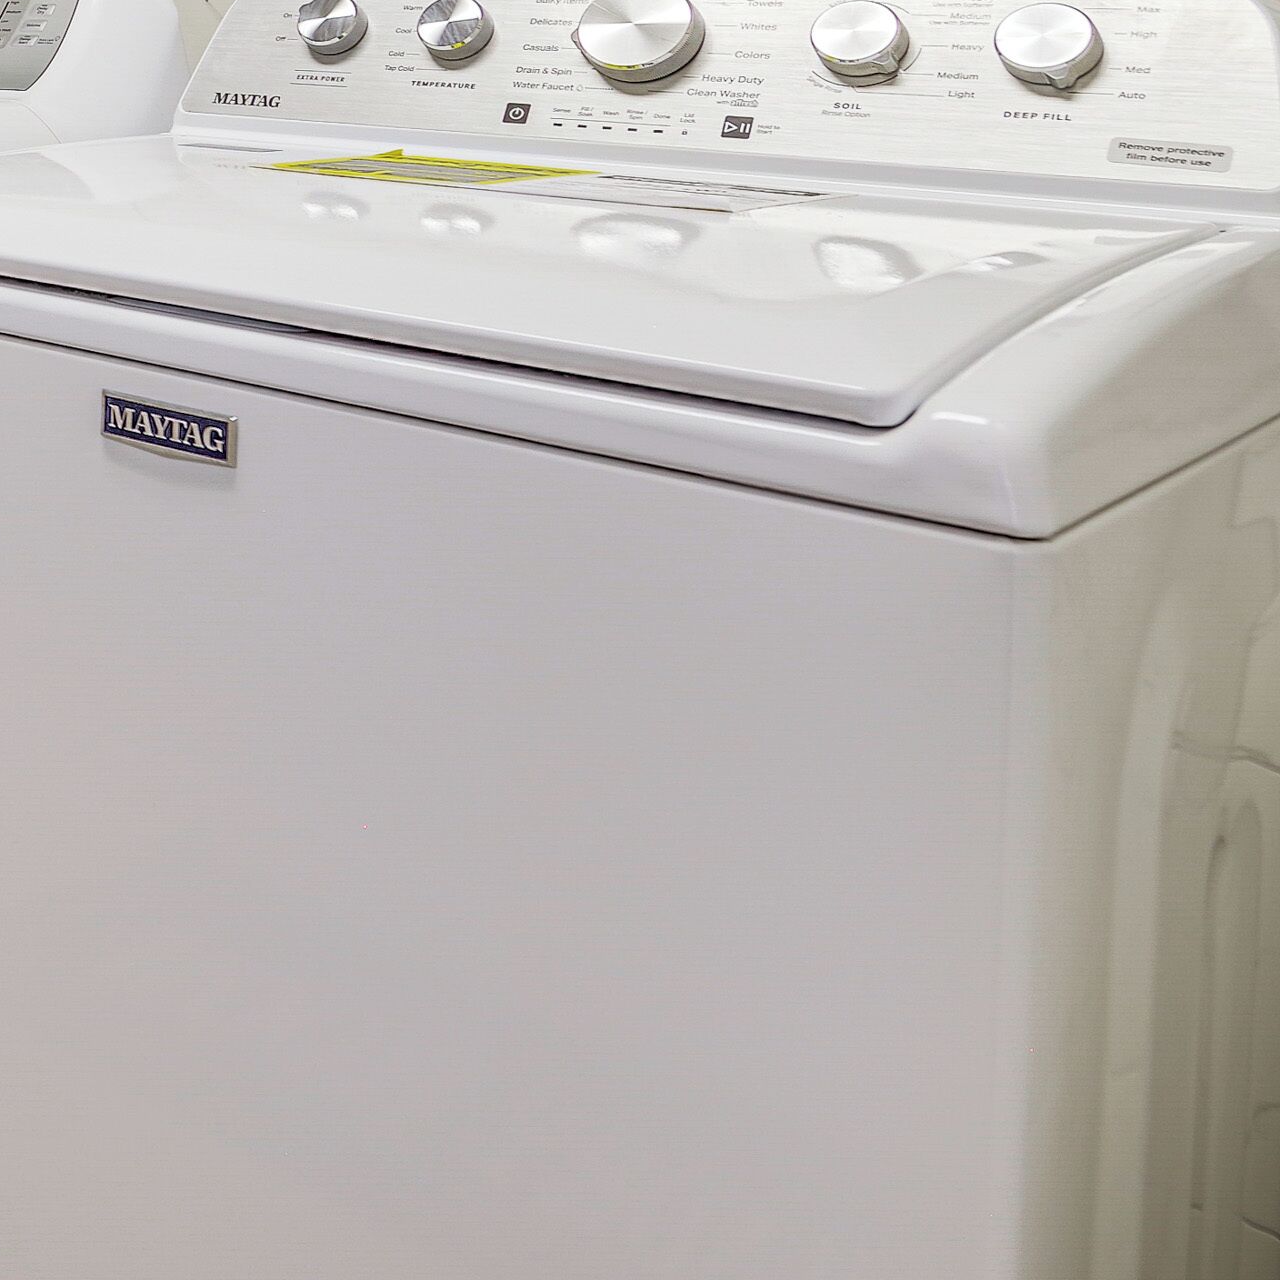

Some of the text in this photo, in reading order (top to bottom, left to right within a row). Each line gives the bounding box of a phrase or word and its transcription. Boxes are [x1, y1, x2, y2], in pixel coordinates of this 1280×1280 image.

[747, 0, 784, 7] Towels
[1137, 6, 1161, 14] Max
[949, 12, 992, 20] Medium
[530, 17, 573, 26] Delicates
[740, 23, 778, 31] Whites
[1130, 30, 1158, 40] High
[522, 43, 559, 52] Casuals
[951, 43, 985, 53] Heavy
[734, 50, 771, 60] Colors
[385, 64, 397, 72] Tap
[516, 66, 572, 76] Drain & Spin
[1125, 66, 1151, 75] Med
[296, 74, 345, 83] EXTRA POWER
[702, 74, 765, 86] Heavy Duty
[937, 72, 979, 81] Medium
[411, 80, 476, 90] TEMPERATURE
[513, 81, 574, 91] Water Faucet
[686, 88, 760, 99] Clean Washer
[947, 90, 975, 100] Light
[1118, 91, 1146, 100] Auto
[212, 92, 281, 108] MAYTAG
[833, 102, 862, 111] SOIL
[821, 110, 871, 119] Rinse Option
[1003, 111, 1072, 122] DEEP FILL
[1118, 142, 1225, 159] Remove protective
[1125, 152, 1212, 167] film before use
[107, 402, 226, 453] MAYTAG
